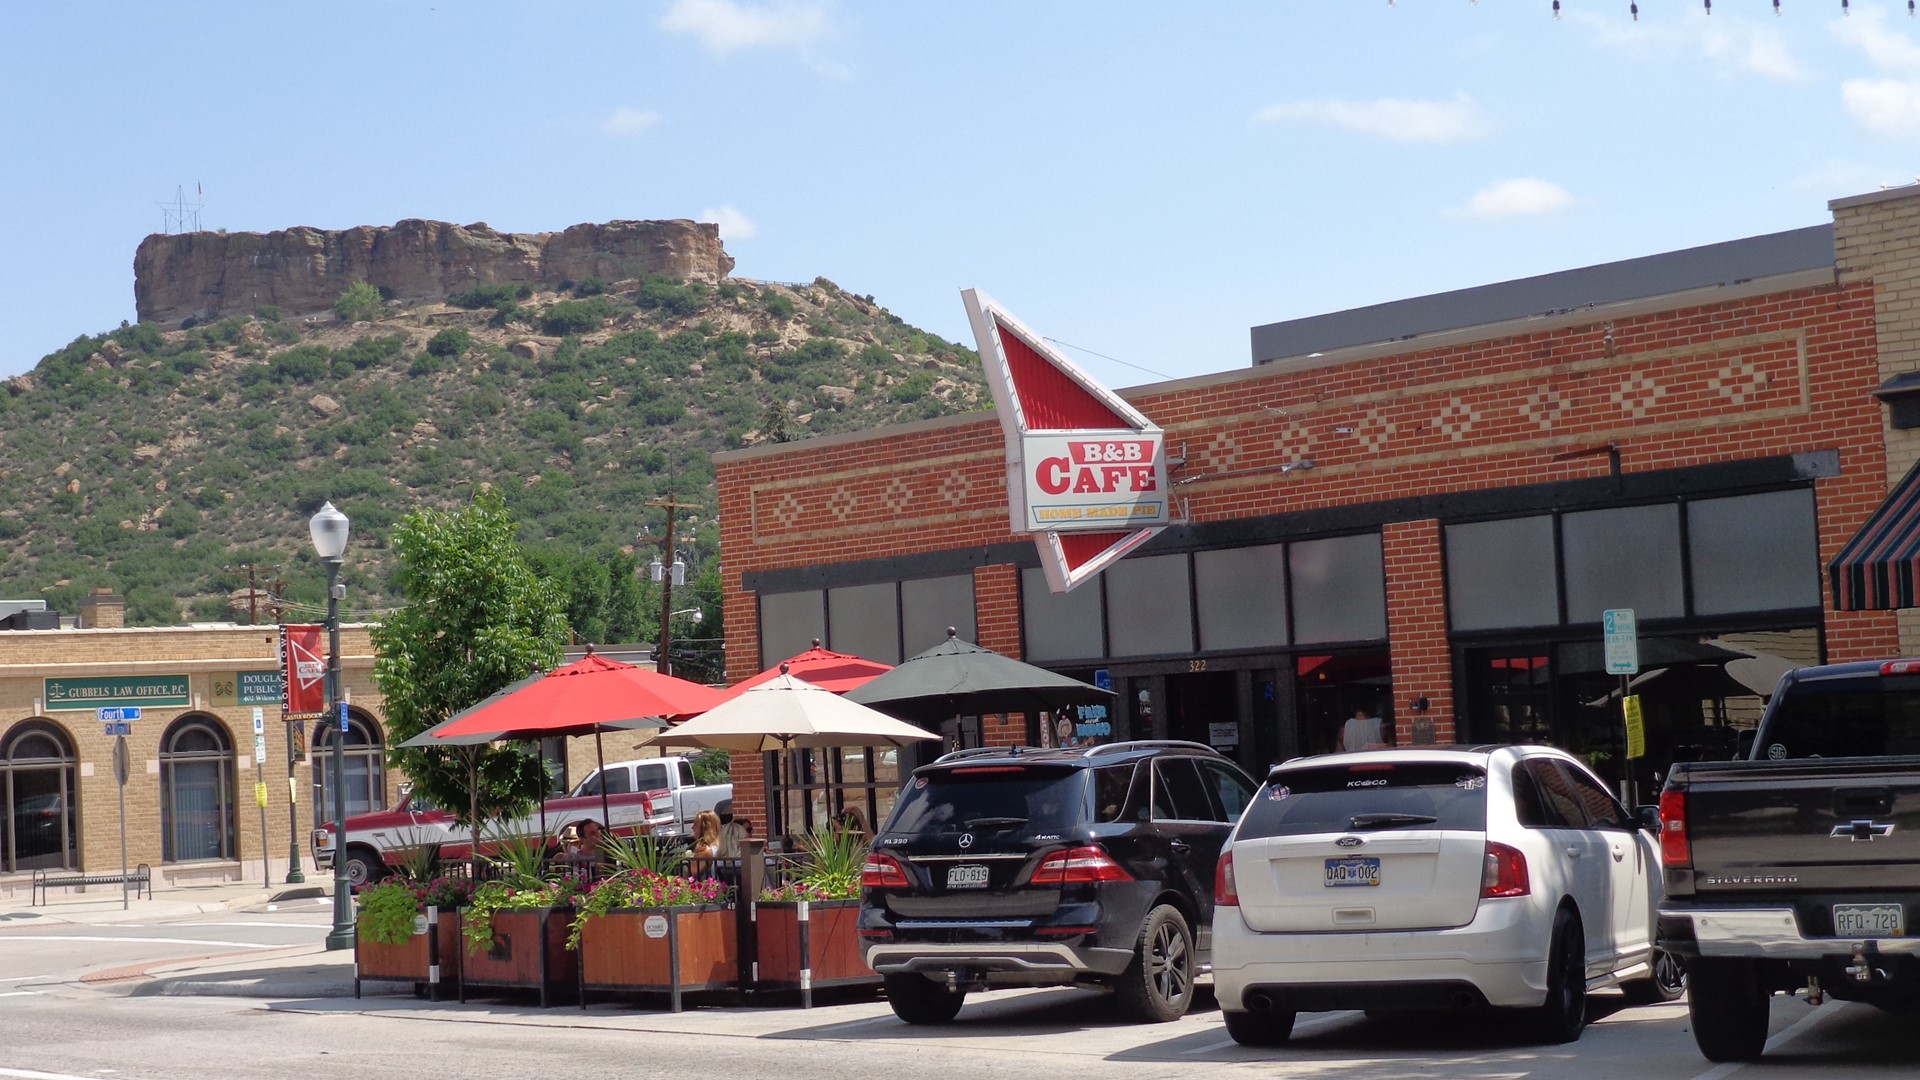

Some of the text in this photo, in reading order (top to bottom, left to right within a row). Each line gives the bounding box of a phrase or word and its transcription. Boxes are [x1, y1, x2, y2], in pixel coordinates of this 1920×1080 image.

[1082, 443, 1142, 462] B&B
[1035, 456, 1156, 495] CAFE
[1039, 505, 1156, 519] HOME MADE PIE
[1606, 614, 1614, 631] 2
[280, 627, 289, 709] DOWNTOWN
[1189, 660, 1207, 672] 322
[243, 675, 282, 684] DOUGLA
[68, 684, 187, 698] GUBBELS LAW OFFICE, P.C.
[243, 685, 277, 694] PUBLIC
[100, 709, 125, 719] Fourth
[1770, 746, 1784, 759] SIG
[1707, 876, 1799, 884] SILVERADO
